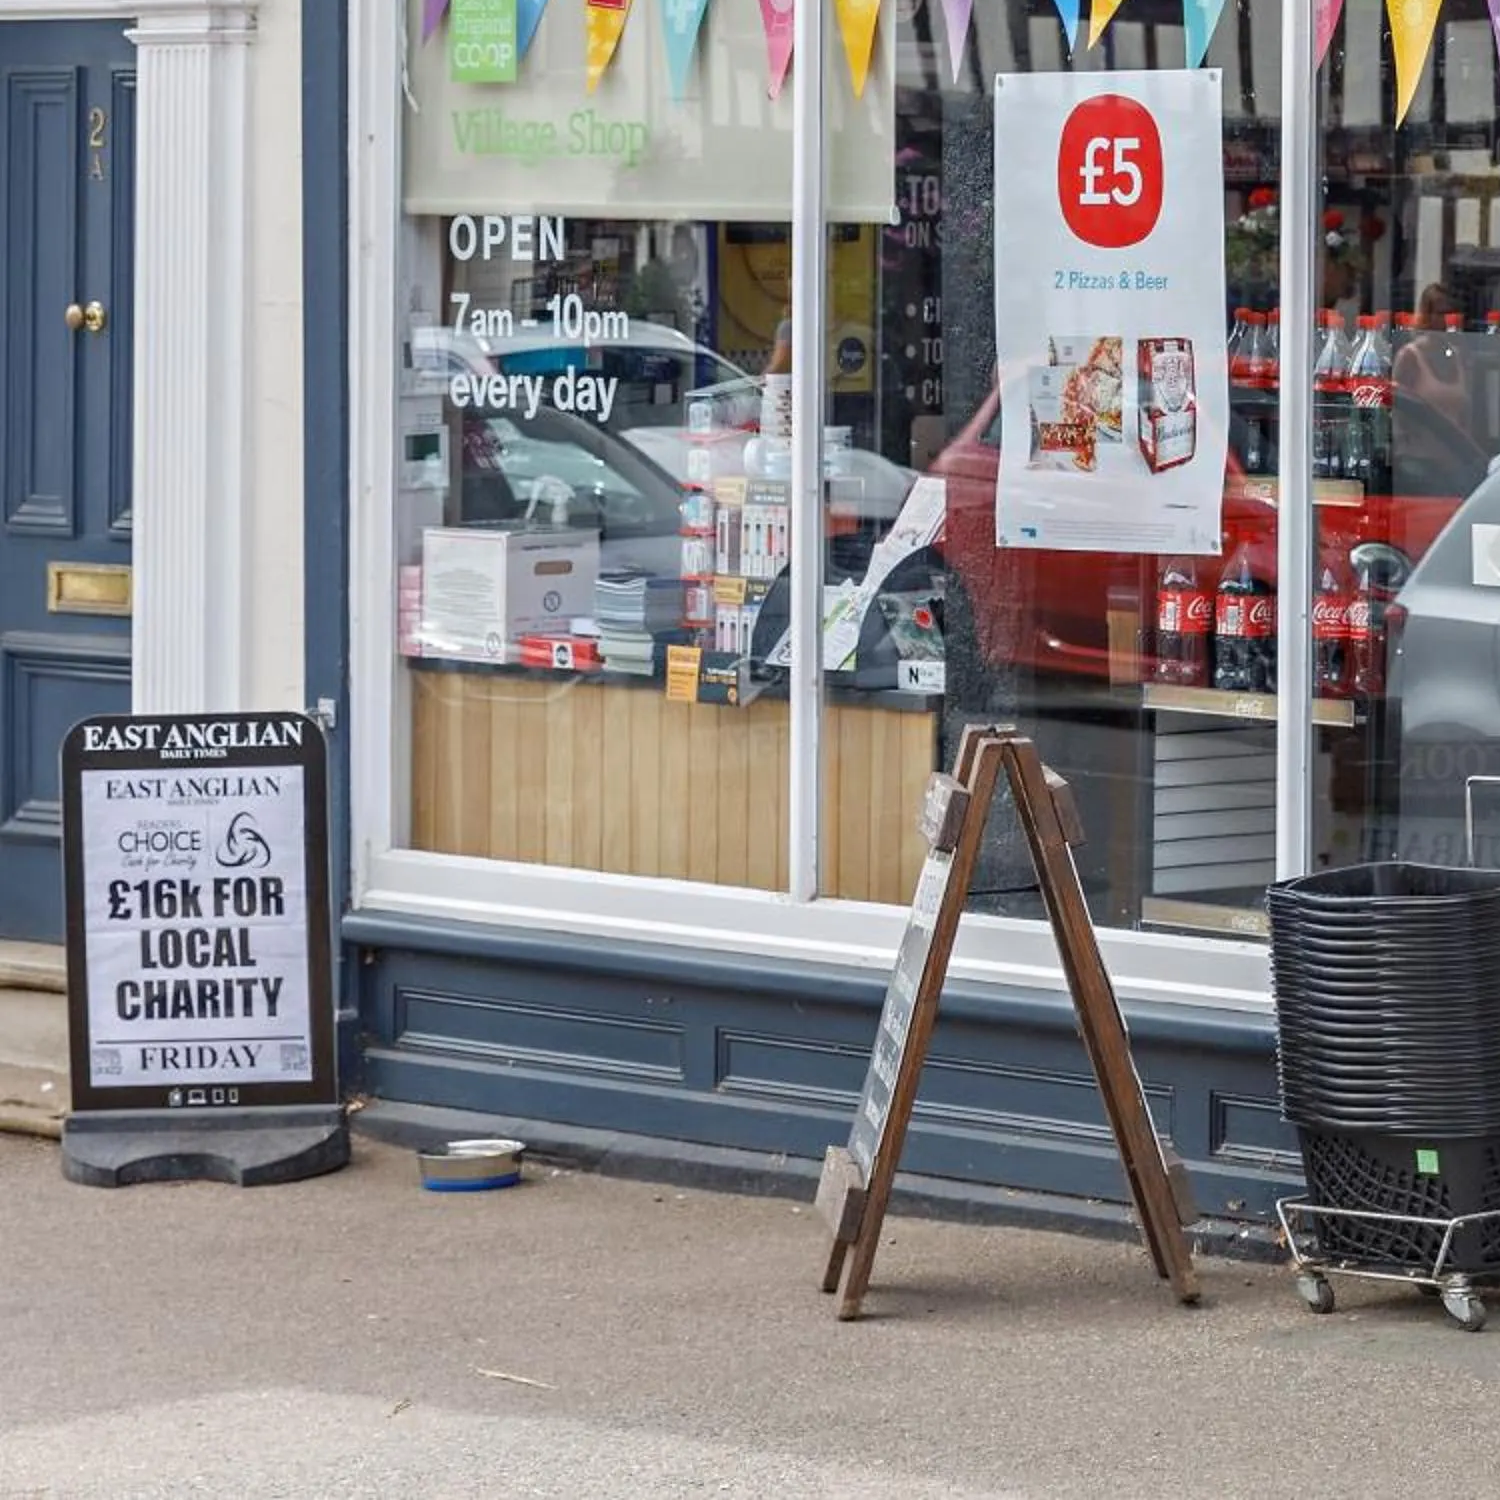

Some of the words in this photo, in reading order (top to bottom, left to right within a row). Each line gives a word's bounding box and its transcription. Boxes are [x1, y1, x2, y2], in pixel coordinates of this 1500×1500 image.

[88, 107, 105, 147] 2
[452, 106, 557, 169] Village
[567, 108, 649, 169] Shop
[1079, 137, 1143, 206] £5
[449, 214, 566, 262] OPEN
[1054, 271, 1064, 289] 2
[1068, 271, 1115, 290] Pizzas
[1119, 271, 1131, 290] &
[1135, 272, 1169, 291] Beer
[450, 293, 513, 339] 7am
[546, 293, 630, 343] 10pm
[449, 371, 544, 419] every
[553, 365, 619, 422] day
[83, 723, 162, 751] EAST
[163, 720, 304, 749] ANGLIAN
[160, 750, 193, 760] DAILY
[194, 748, 228, 759] TIMES
[106, 779, 168, 800] EAST
[169, 775, 282, 798] ANGLIAN
[118, 830, 202, 854] CHOICE
[107, 878, 202, 920] £16k
[212, 876, 285, 918] FOR
[140, 926, 258, 970] LOCAL
[115, 976, 285, 1022] CHARITY
[138, 1043, 264, 1072] FRIDAY
